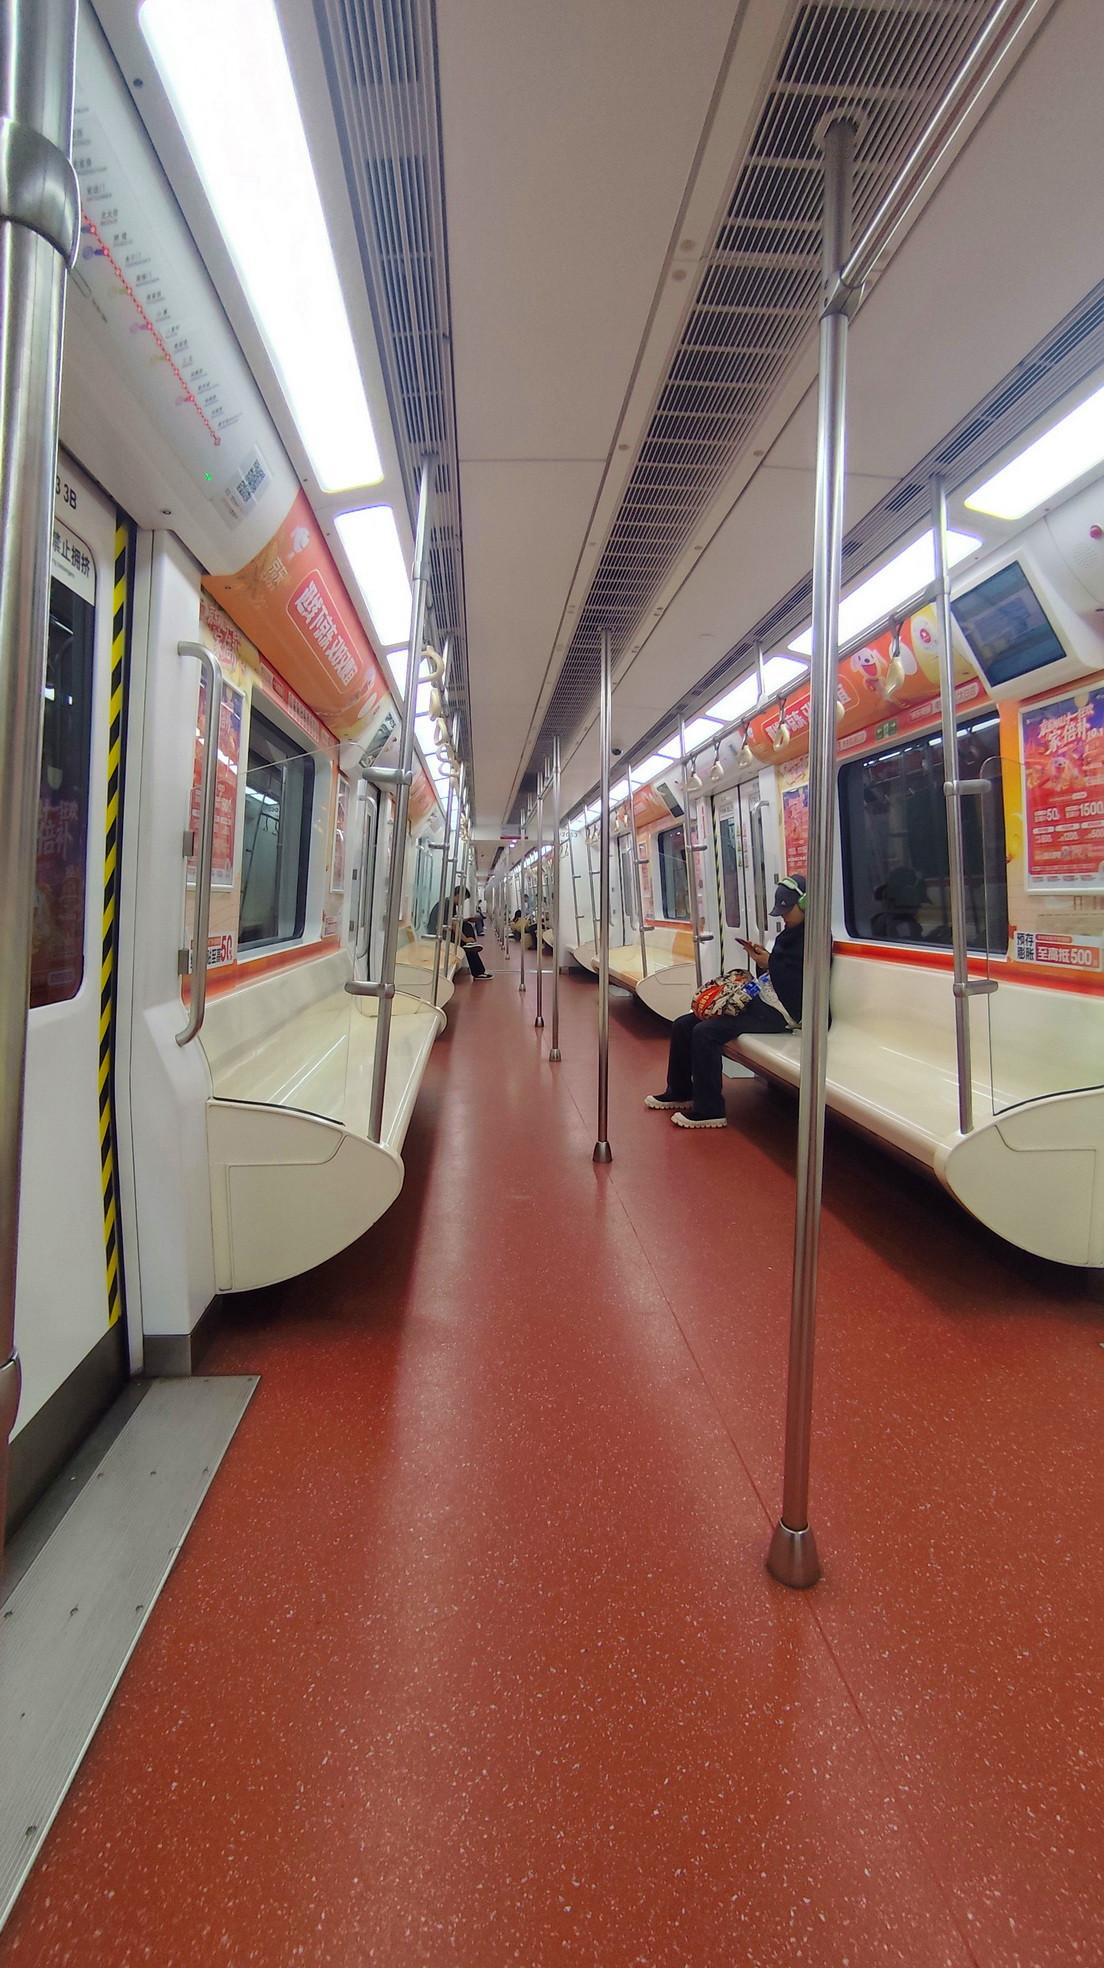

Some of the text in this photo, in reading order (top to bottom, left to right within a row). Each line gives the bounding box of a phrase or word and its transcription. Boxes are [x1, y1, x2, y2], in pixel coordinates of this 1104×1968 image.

[63, 484, 77, 510] 3B
[53, 532, 90, 577] 禁止拥挤
[1016, 932, 1034, 946] 预存
[1017, 946, 1092, 965] 膨胀 至高抵500
